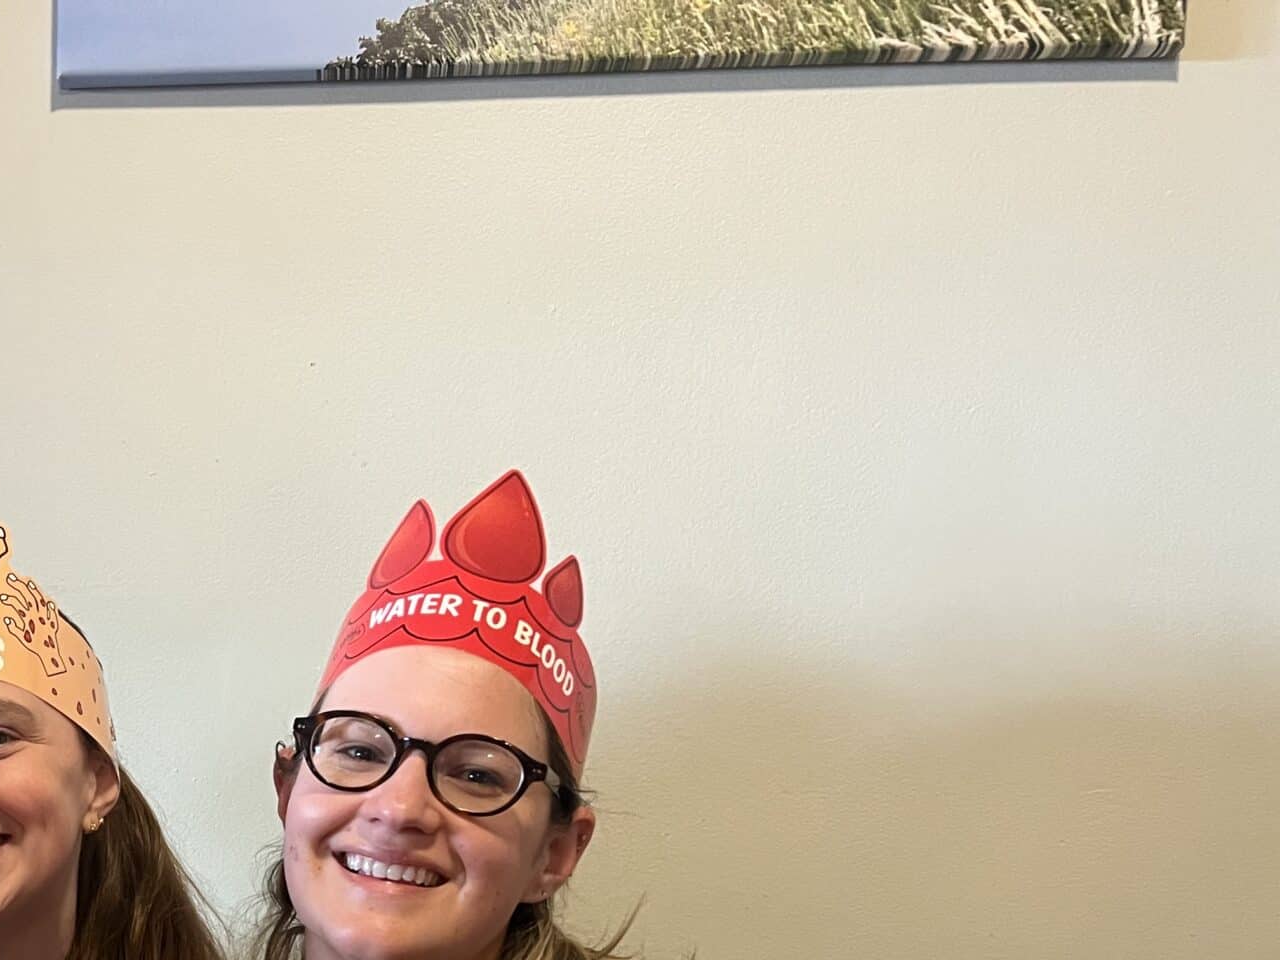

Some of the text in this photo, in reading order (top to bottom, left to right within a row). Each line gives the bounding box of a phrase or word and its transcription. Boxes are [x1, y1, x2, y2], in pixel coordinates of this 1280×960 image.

[369, 592, 574, 697] WATER TO BLOOD
